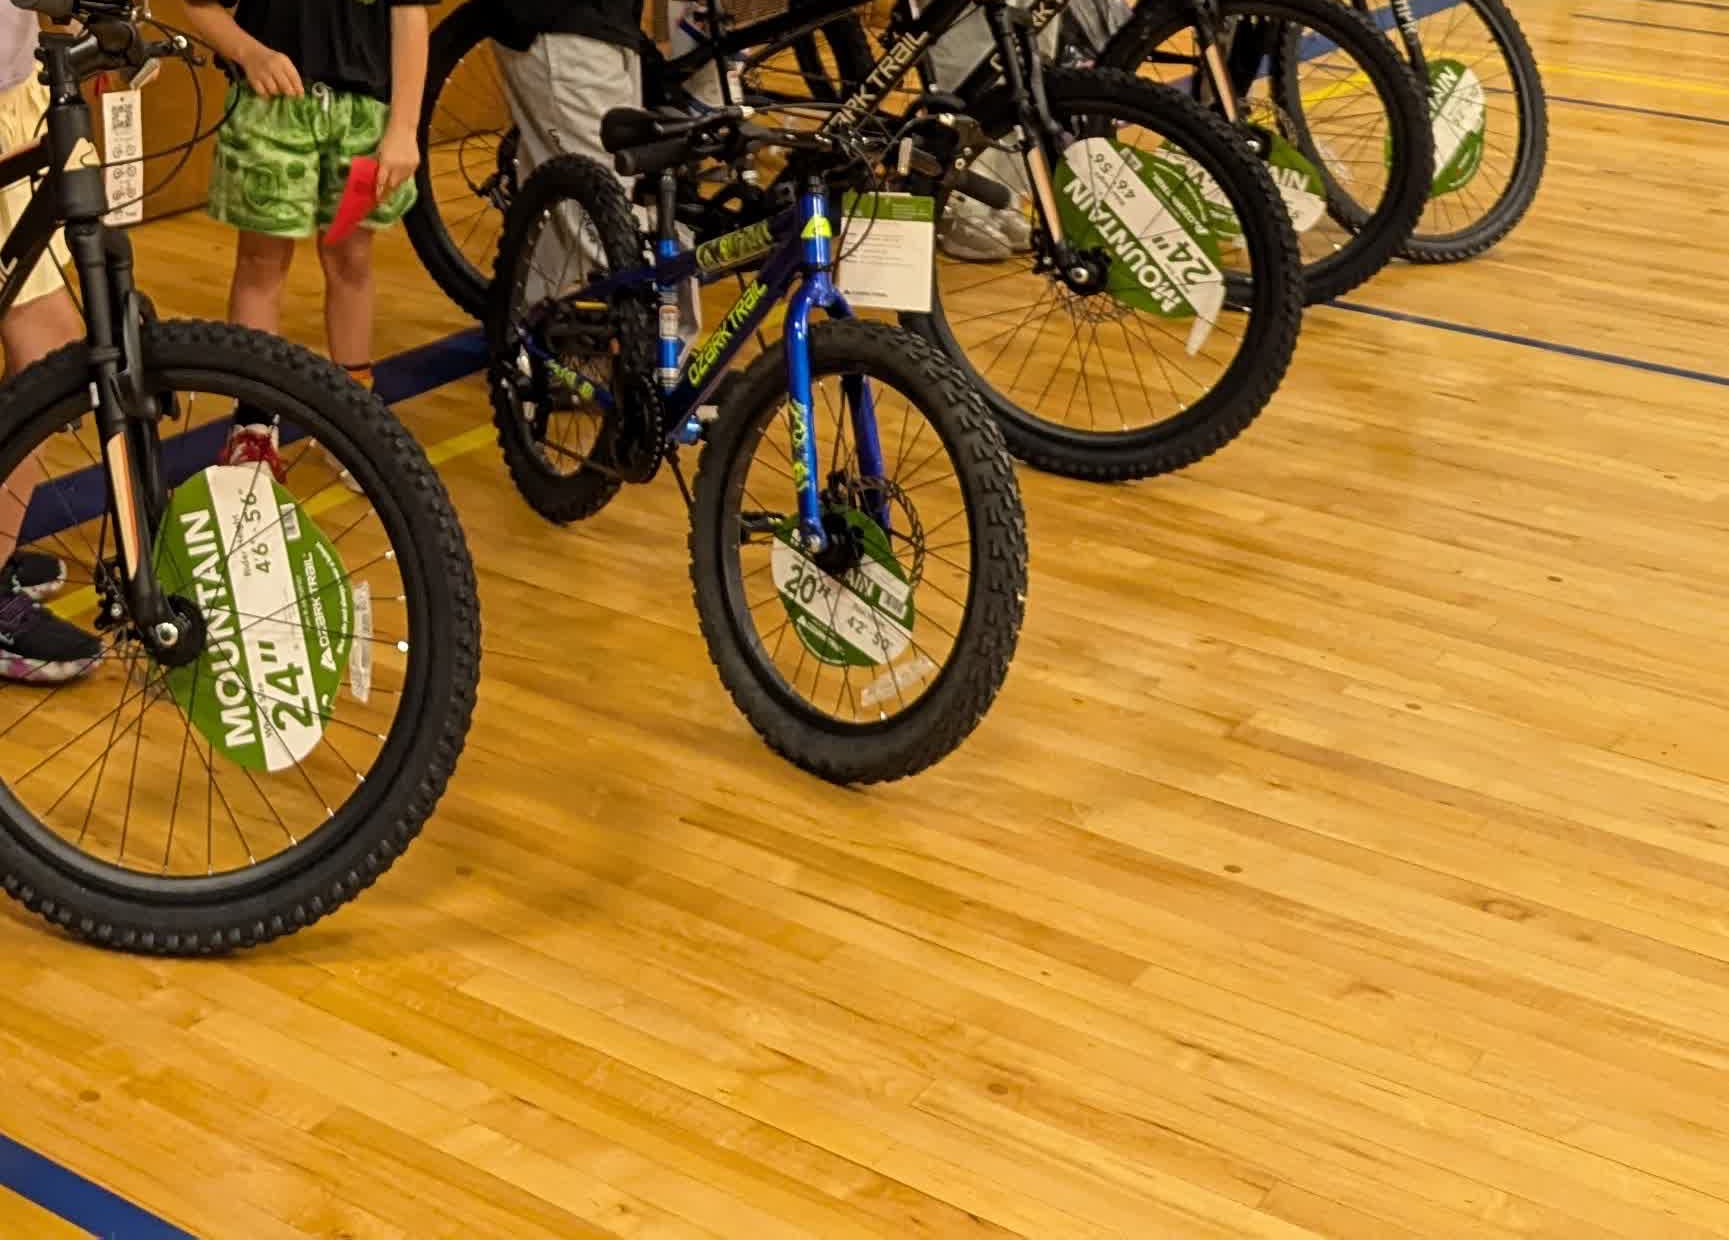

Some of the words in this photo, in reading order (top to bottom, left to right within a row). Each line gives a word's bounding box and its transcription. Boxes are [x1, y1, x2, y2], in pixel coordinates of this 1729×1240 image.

[1063, 178, 1182, 312] MOUNTAIN
[1152, 235, 1212, 286] 24"
[180, 509, 257, 747] MOUNTAIN
[257, 639, 315, 732] 24"
